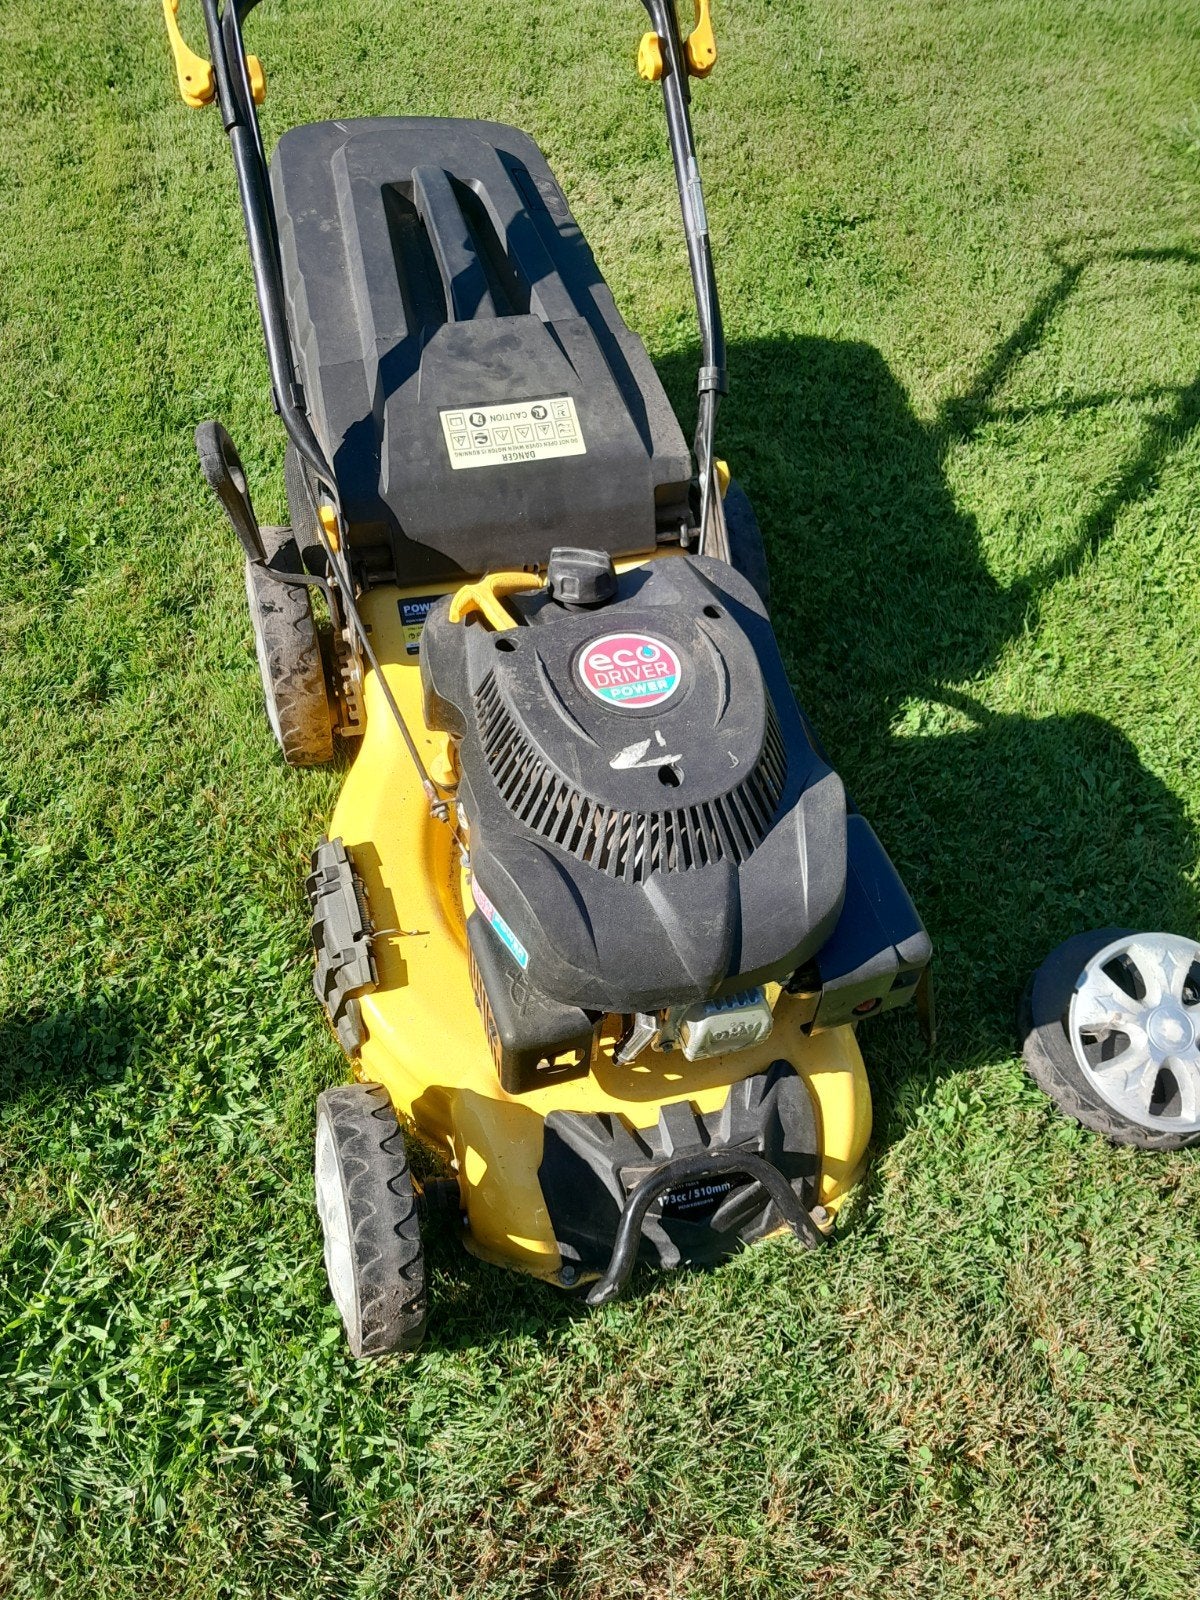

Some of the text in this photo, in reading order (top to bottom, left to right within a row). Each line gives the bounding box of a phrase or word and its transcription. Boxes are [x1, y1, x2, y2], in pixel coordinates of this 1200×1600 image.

[490, 411, 527, 422] CAUTION
[454, 449, 481, 457] RUNNING
[502, 450, 536, 462] DANGER
[588, 644, 661, 671] eco
[594, 661, 670, 687] DRIVER
[611, 679, 669, 700] POWER
[657, 1194, 687, 1207] 173cc
[694, 1182, 731, 1198] 510mm
